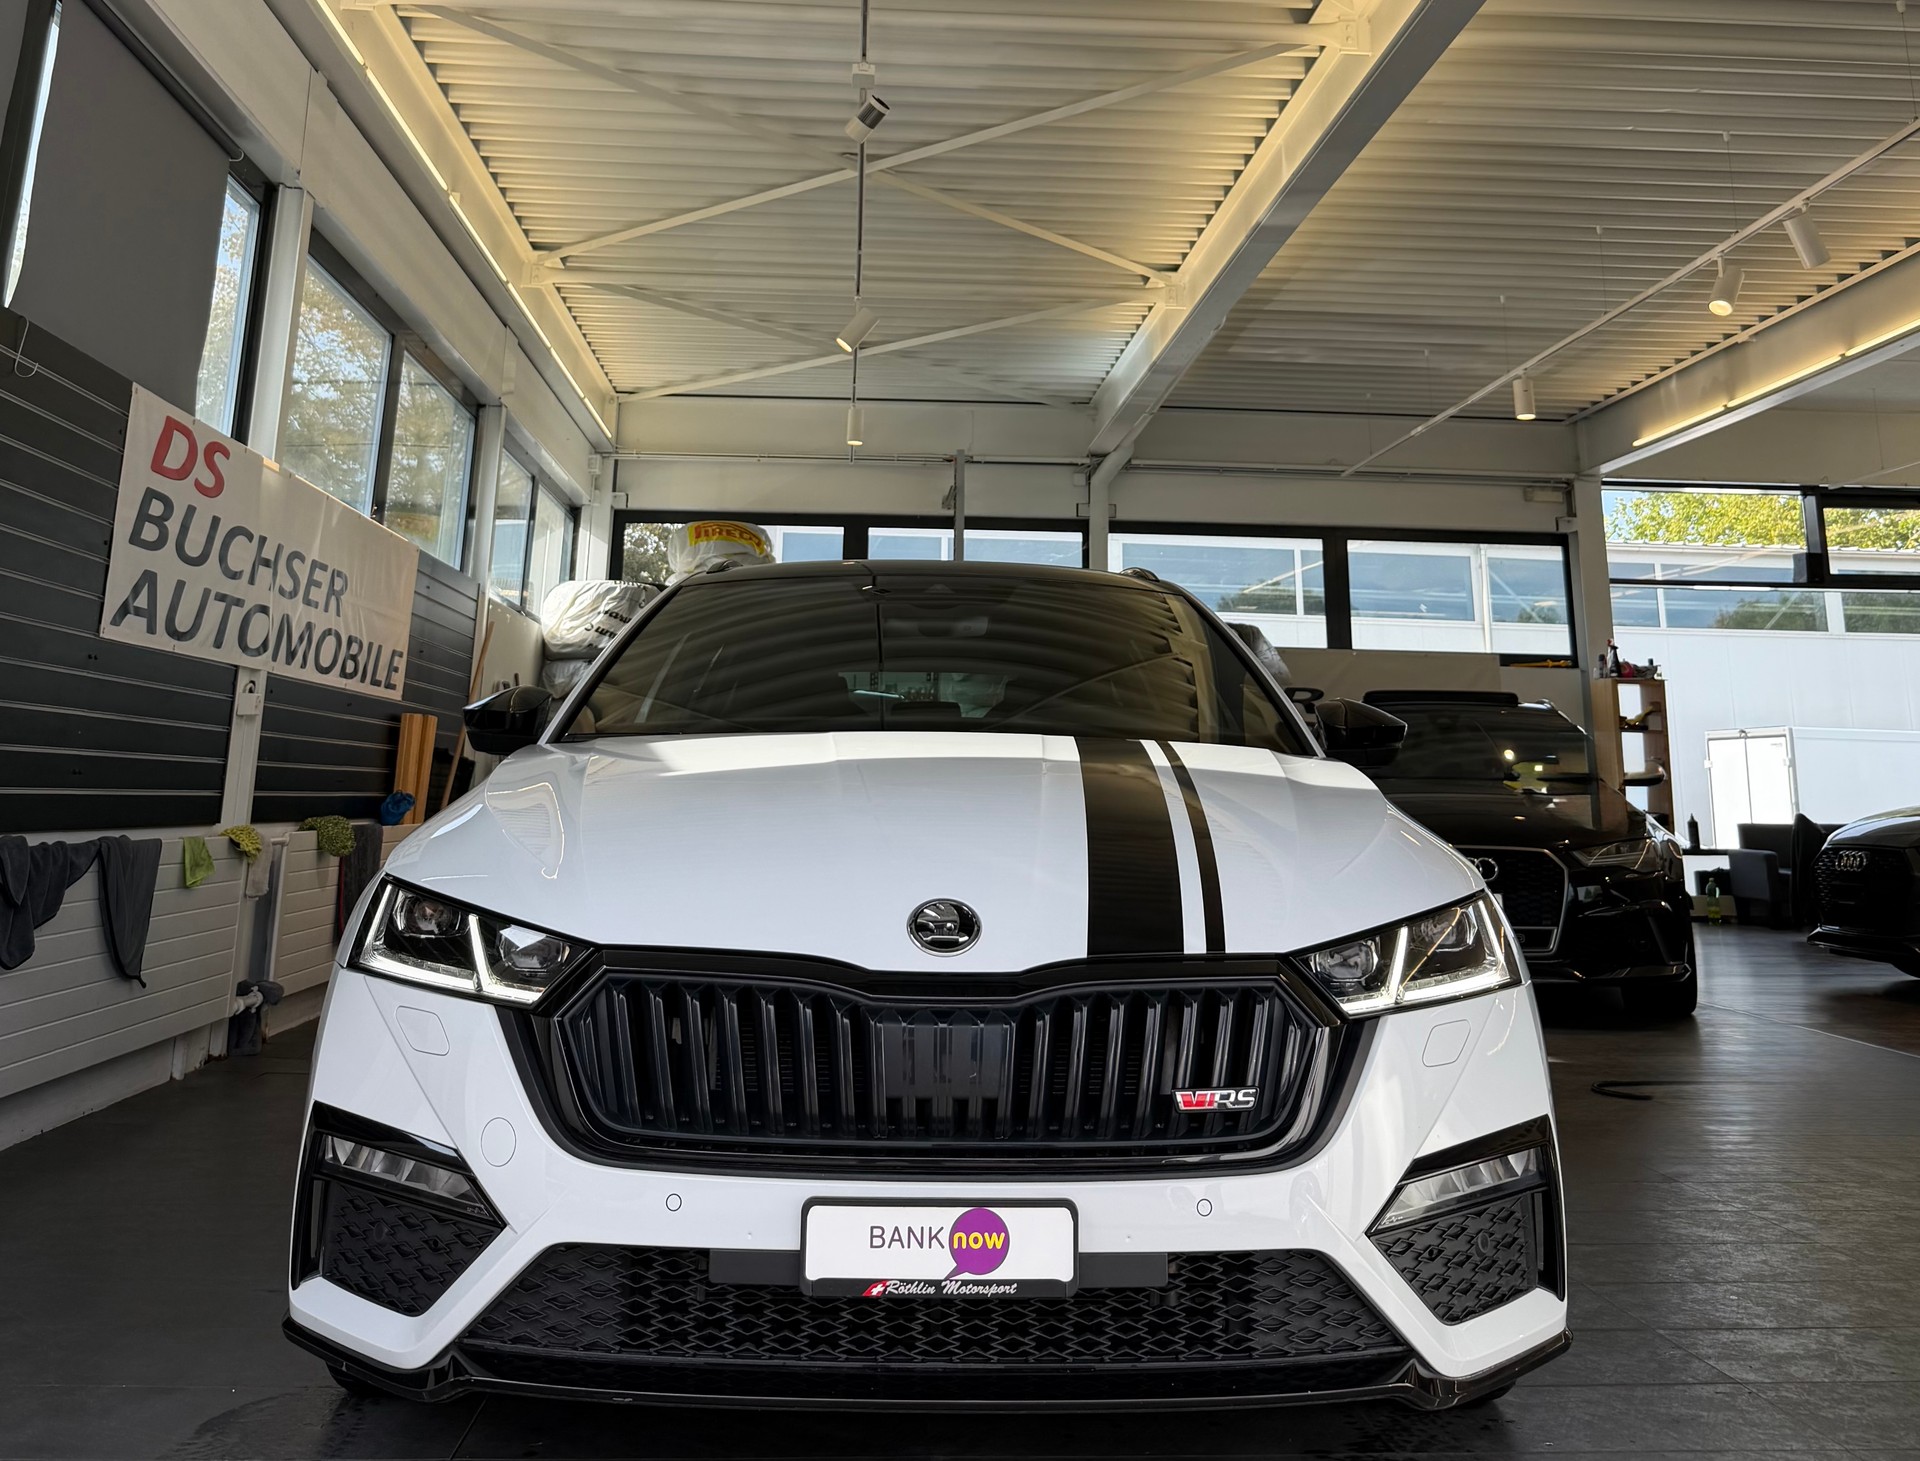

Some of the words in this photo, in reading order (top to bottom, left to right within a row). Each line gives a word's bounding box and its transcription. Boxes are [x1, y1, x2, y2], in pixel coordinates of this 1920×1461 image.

[150, 415, 230, 498] DS
[128, 486, 349, 617] BUCHSER
[109, 569, 404, 691] AUTOMOBILE
[869, 1225, 945, 1249] BANK
[952, 1231, 1005, 1250] now
[886, 1280, 936, 1295] Röthlin
[941, 1280, 1018, 1298] Motorsport
